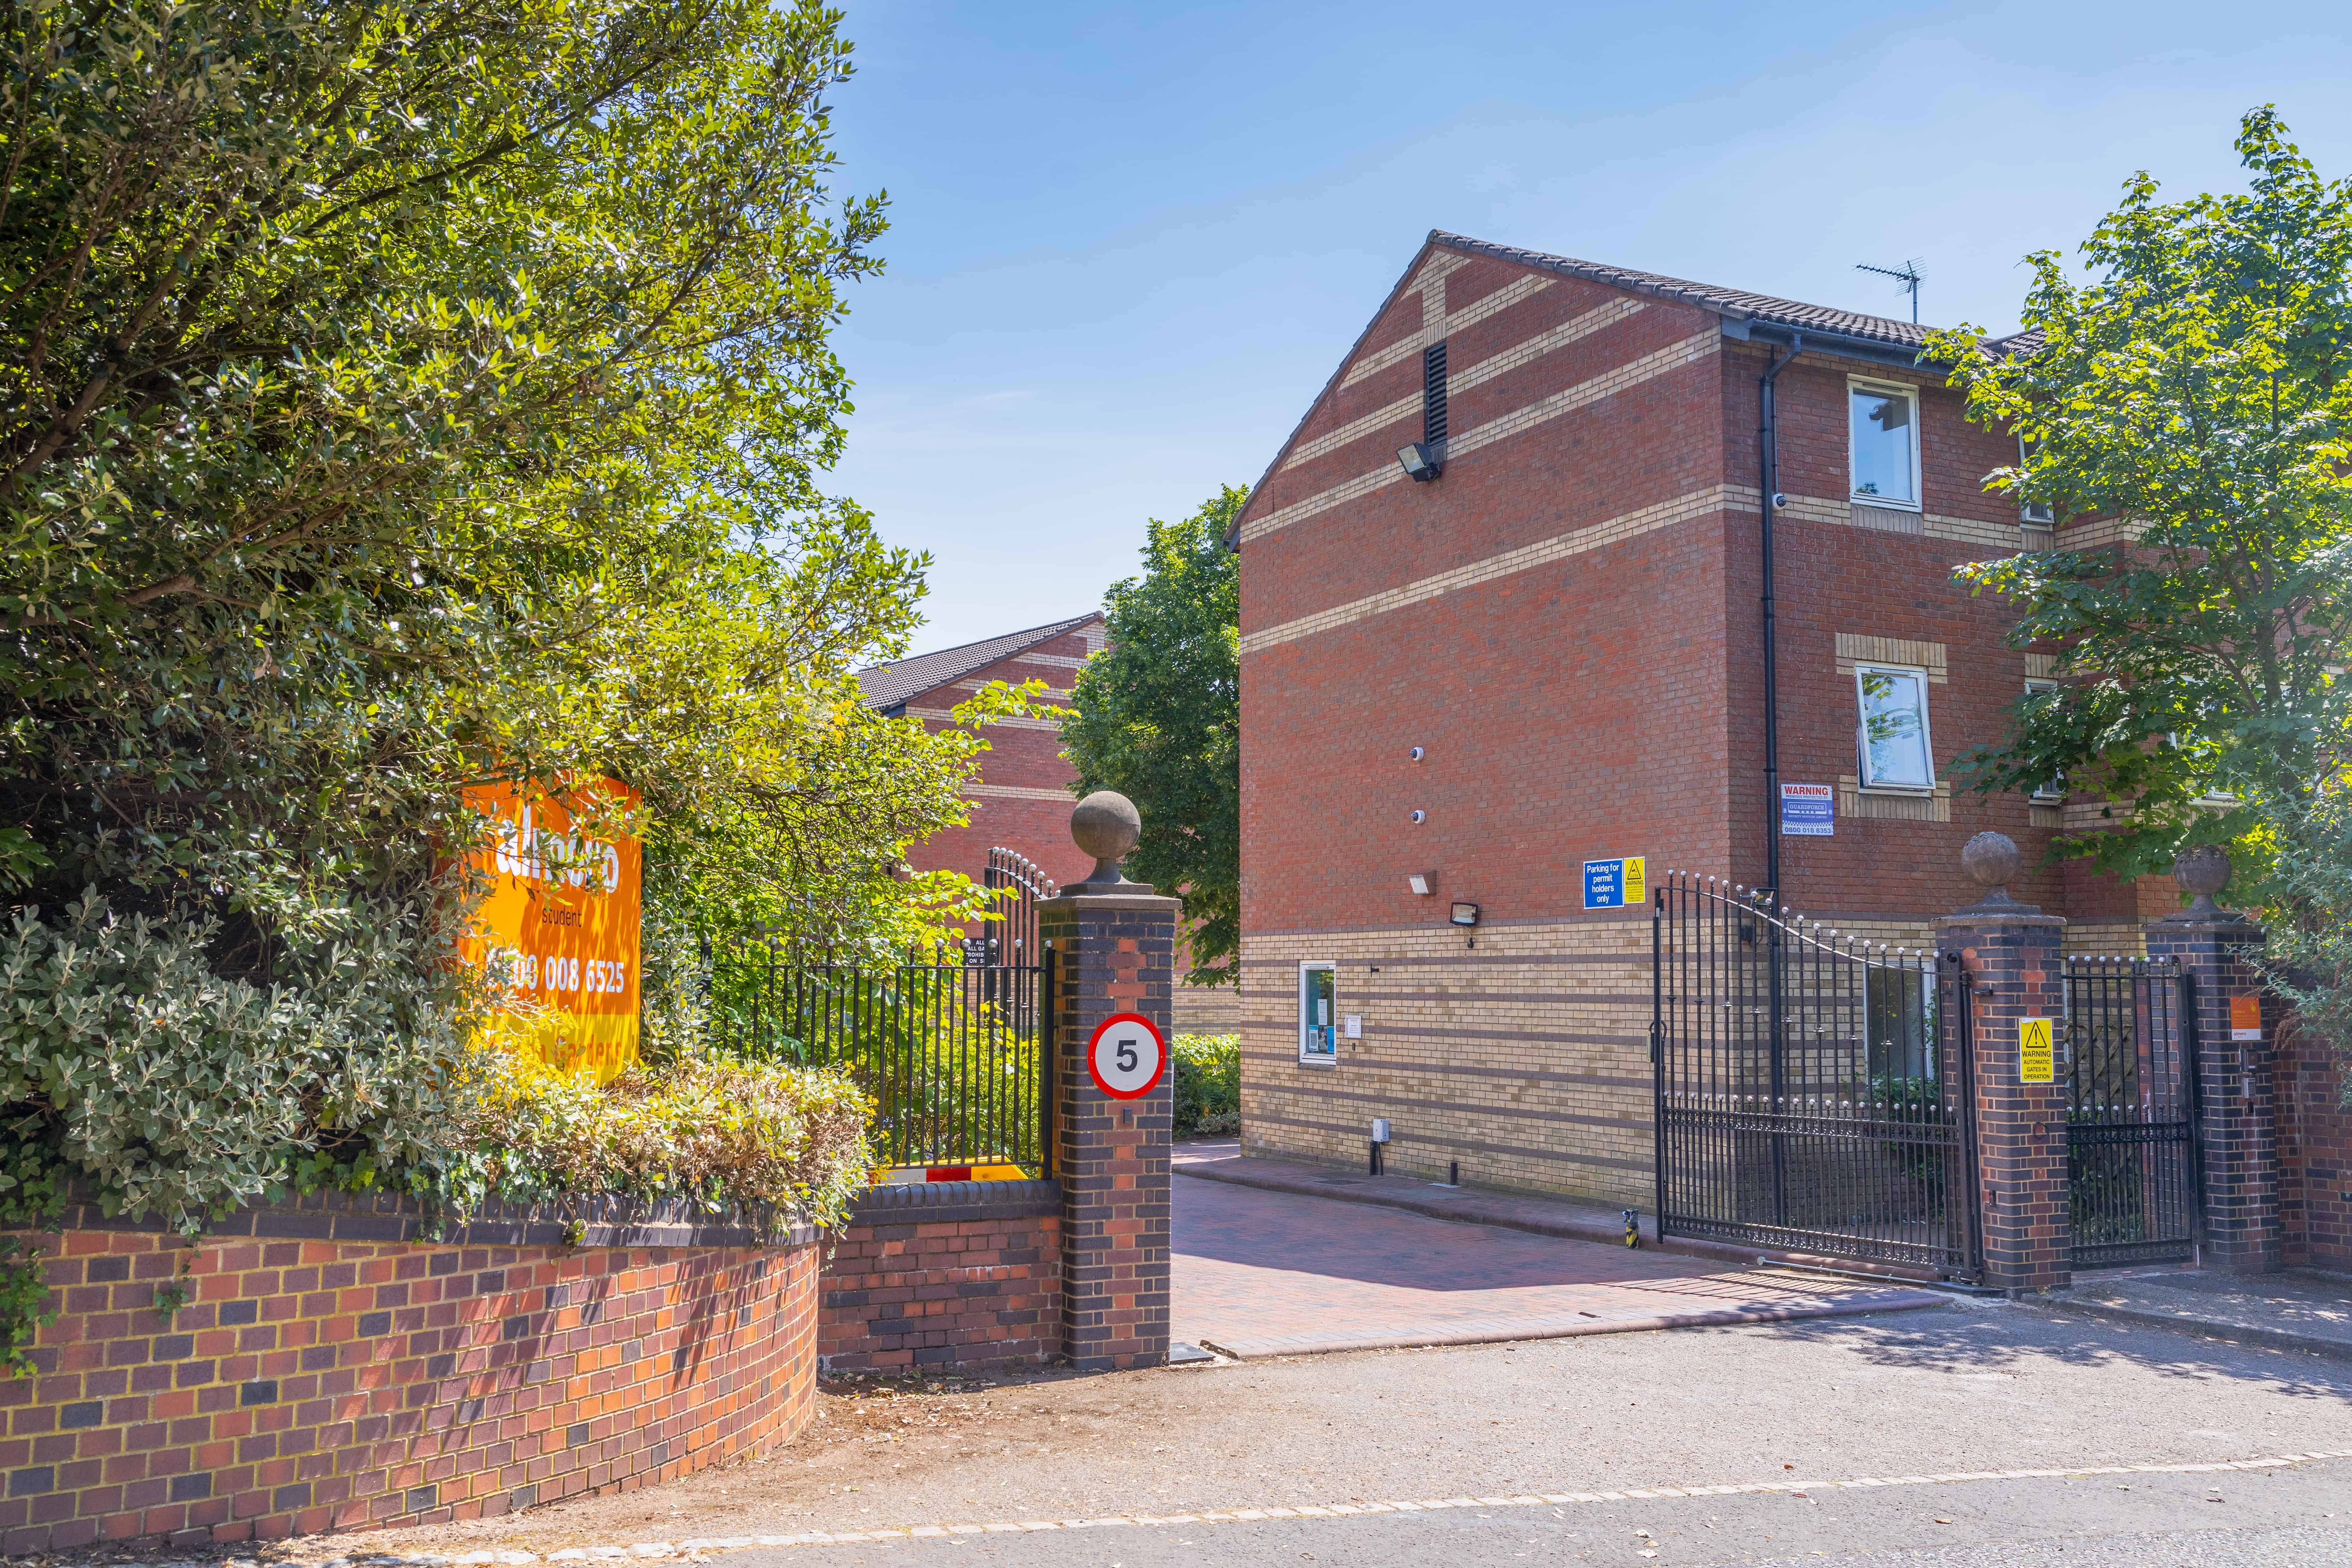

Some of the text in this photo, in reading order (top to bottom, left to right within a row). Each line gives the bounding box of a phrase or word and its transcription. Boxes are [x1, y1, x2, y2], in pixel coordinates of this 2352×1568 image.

[1784, 786, 1828, 796] WARNING
[1587, 863, 1619, 873] Parking for
[1593, 874, 1612, 884] permit
[1592, 884, 1614, 893] holders
[1597, 894, 1609, 904] only
[542, 905, 582, 928] student
[545, 956, 579, 991] 008
[585, 959, 624, 993] 6525
[1116, 1040, 1138, 1072] 5
